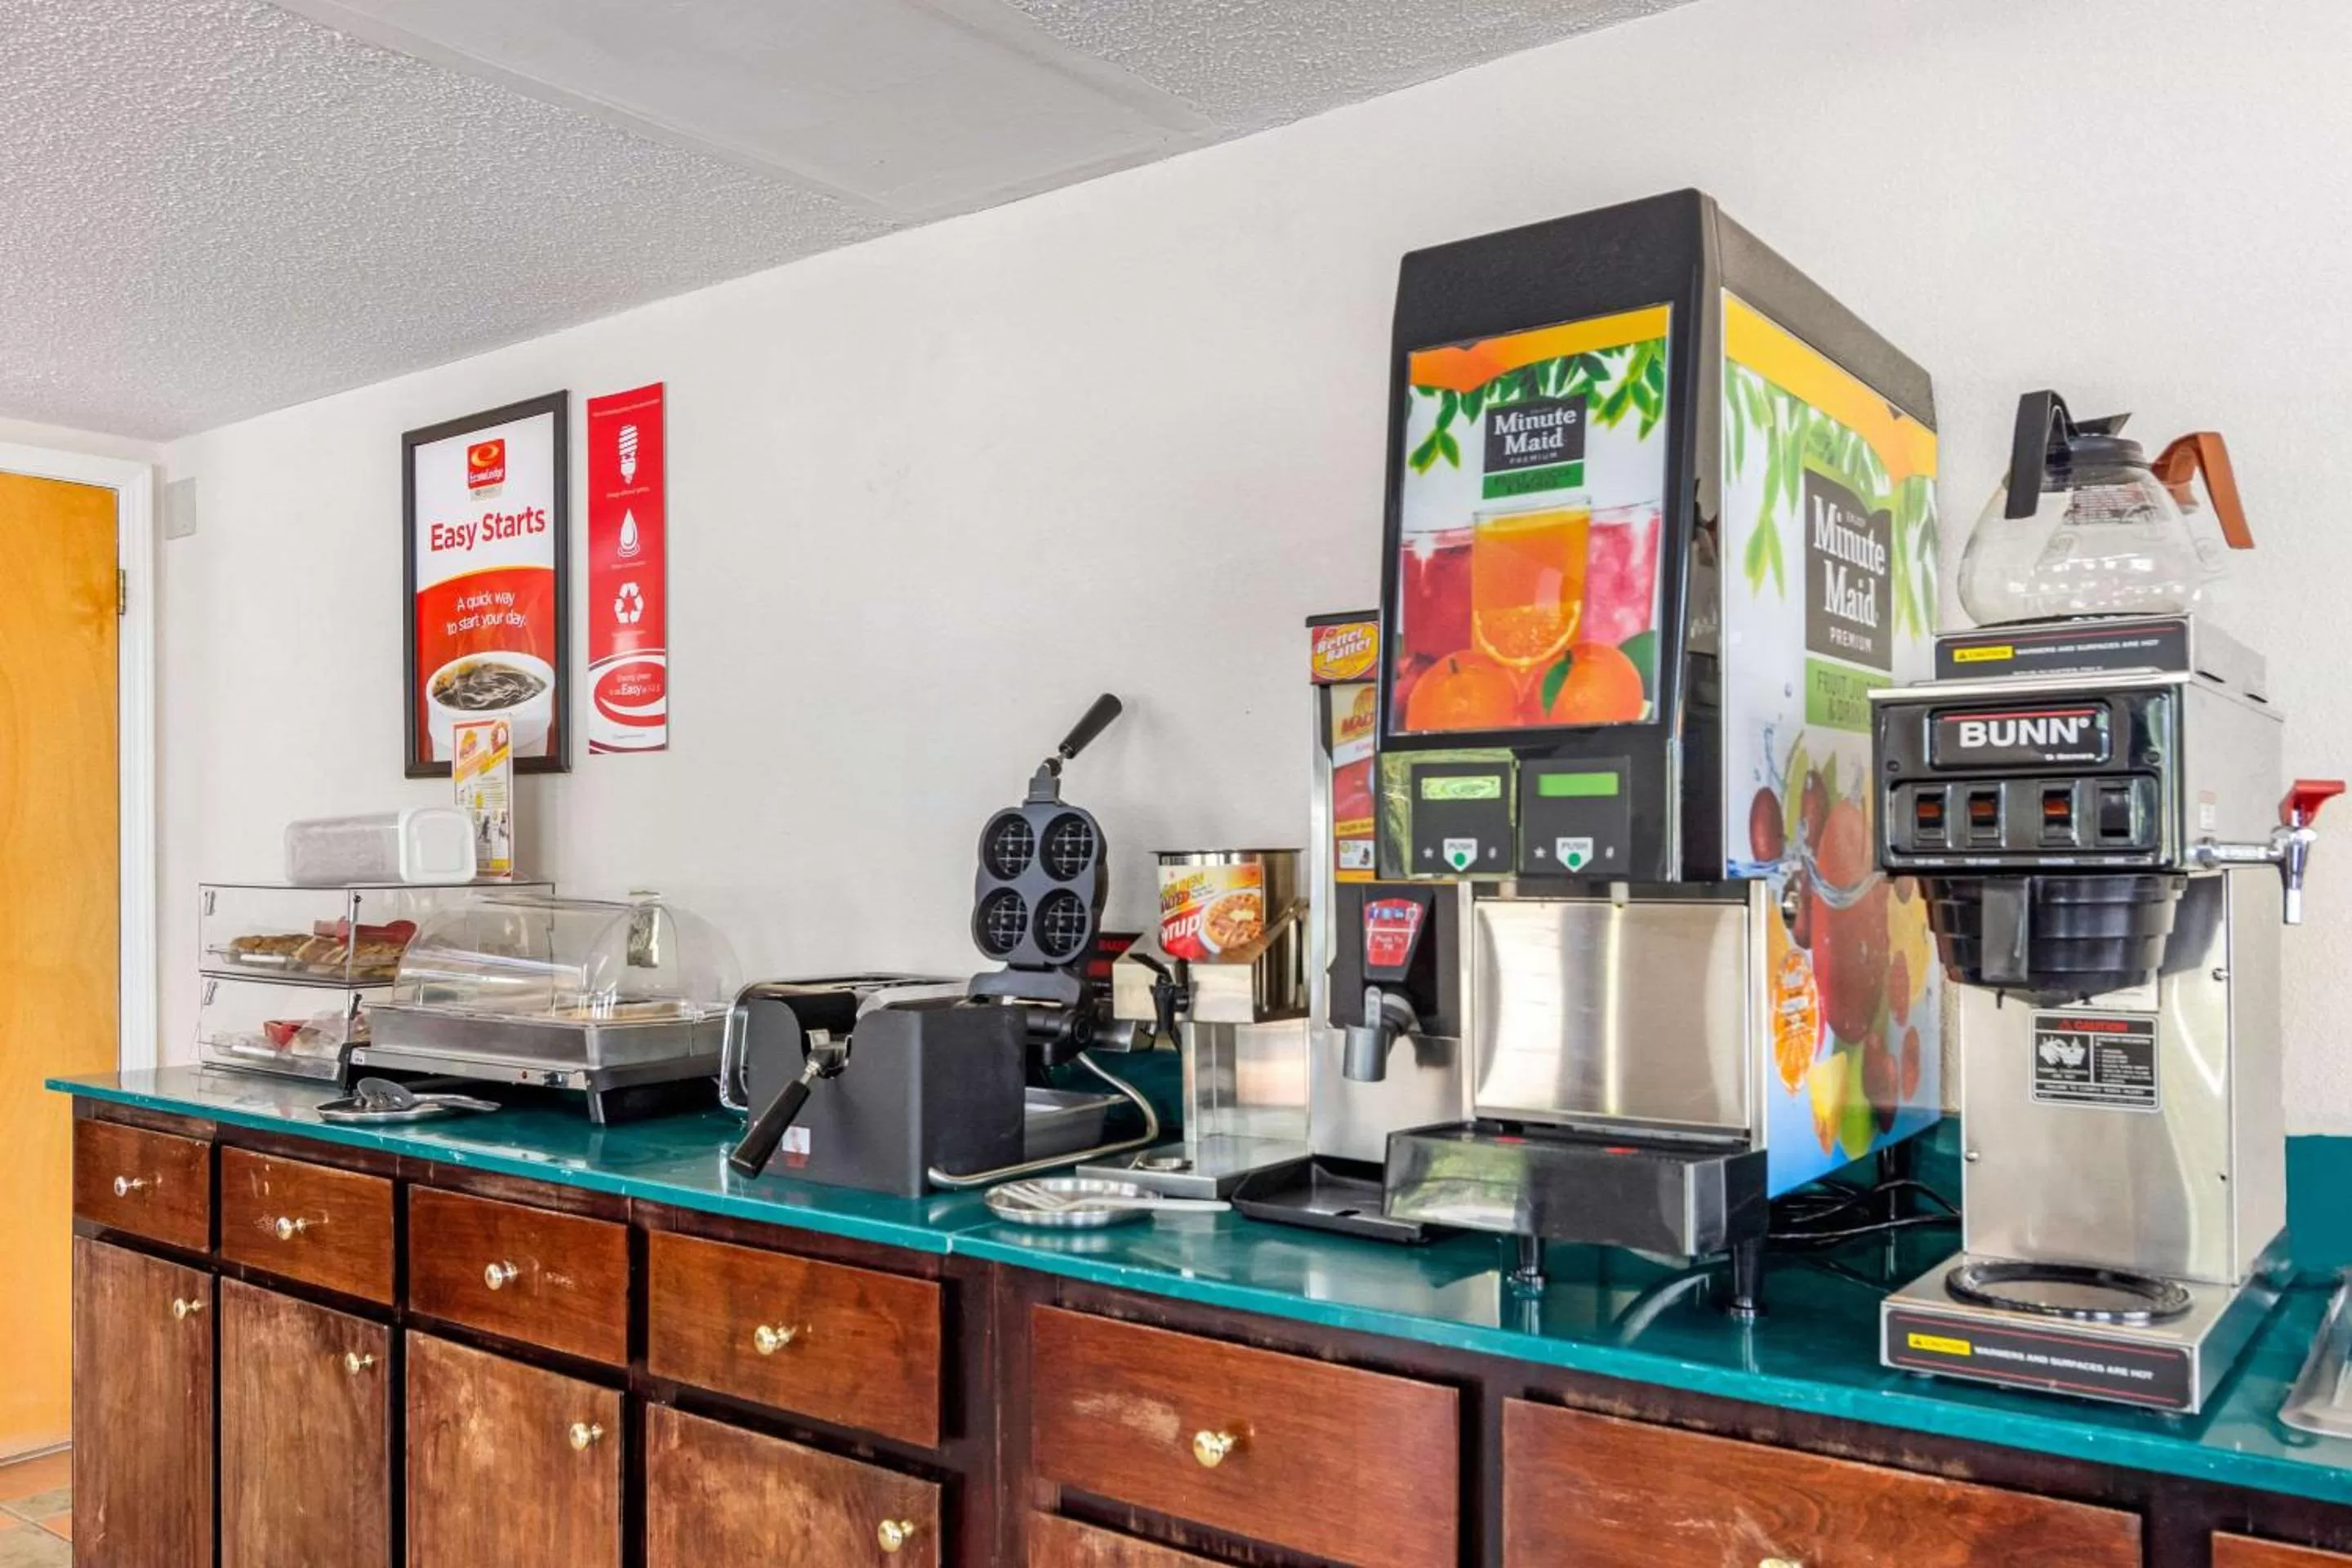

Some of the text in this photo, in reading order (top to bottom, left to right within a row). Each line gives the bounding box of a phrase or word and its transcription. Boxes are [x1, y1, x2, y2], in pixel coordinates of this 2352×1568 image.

[1494, 407, 1578, 435] Minute
[1503, 426, 1565, 456] Maid
[430, 506, 546, 551] Easy Starts
[1812, 494, 1886, 577] Minute
[457, 590, 515, 612] A quick way
[1824, 559, 1878, 628] Maid
[447, 622, 457, 636] to
[459, 613, 480, 631] start
[481, 612, 504, 628] your
[1829, 626, 1872, 653] PREMIUM
